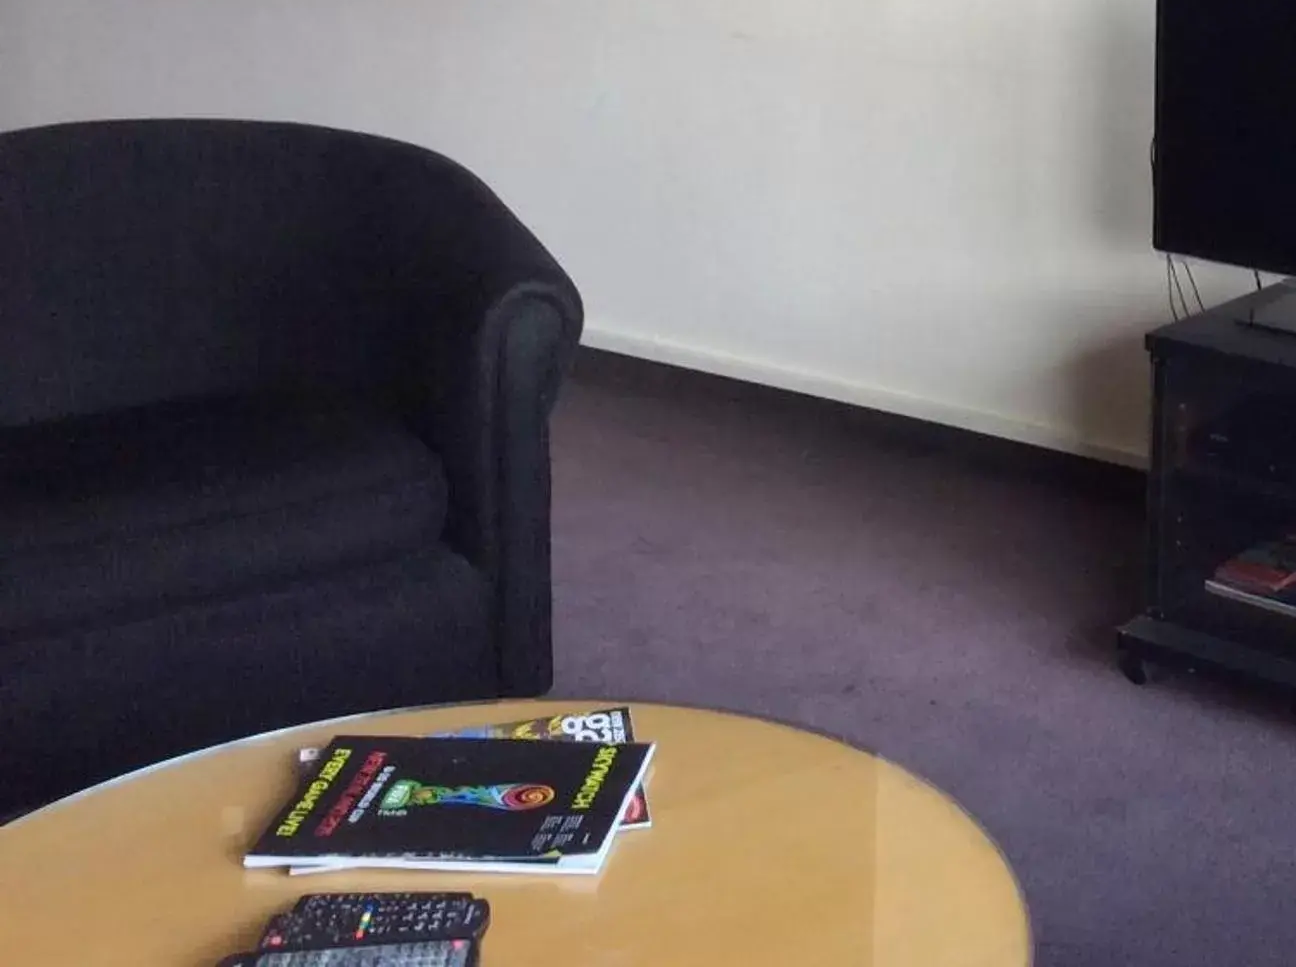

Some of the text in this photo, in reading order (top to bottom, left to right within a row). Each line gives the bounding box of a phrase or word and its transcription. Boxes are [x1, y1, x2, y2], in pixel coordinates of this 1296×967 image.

[317, 748, 352, 781] EVERY
[566, 745, 618, 808] SKYWATCH
[294, 780, 329, 810] GAME
